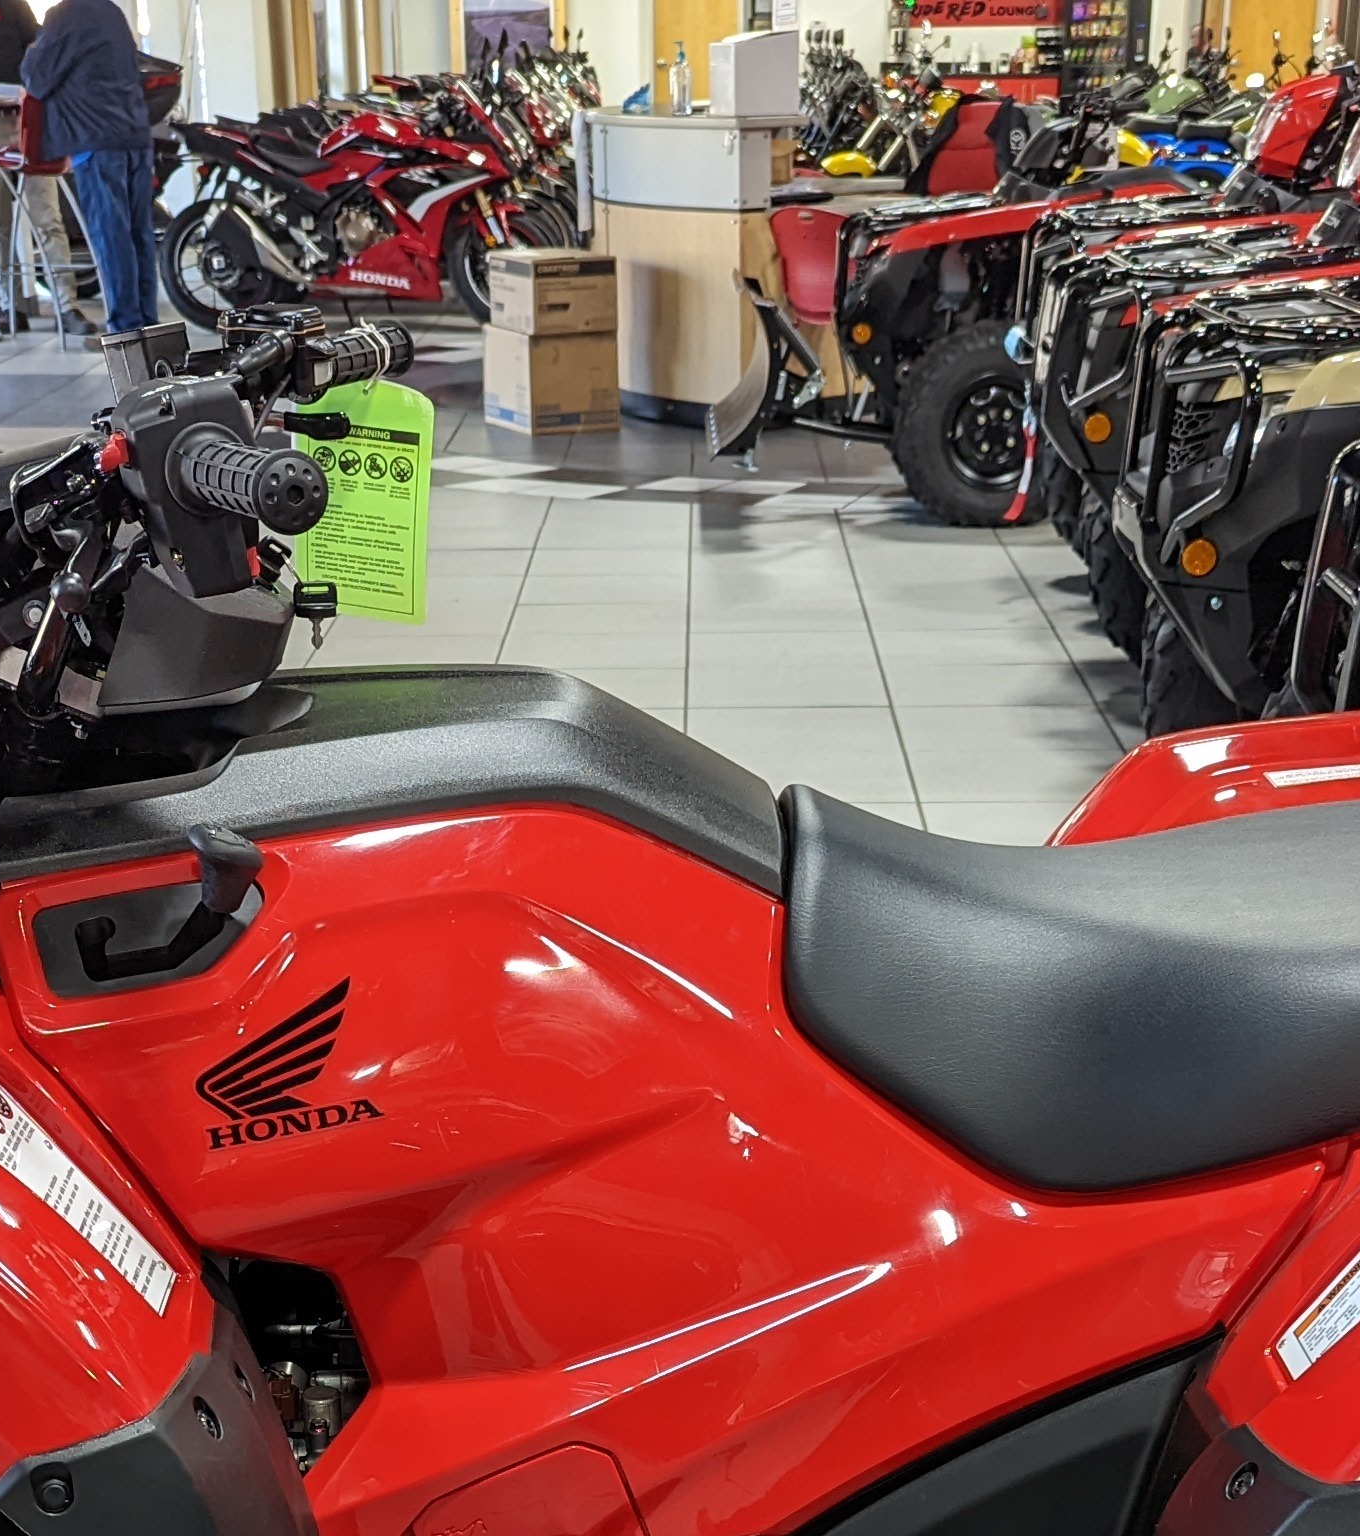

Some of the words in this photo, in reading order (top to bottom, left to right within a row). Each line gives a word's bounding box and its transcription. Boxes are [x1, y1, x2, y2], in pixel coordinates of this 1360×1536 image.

[945, 0, 987, 22] RED
[990, 5, 1047, 17] LOUNG
[349, 269, 411, 290] HONDA
[349, 427, 391, 440] WARNING
[206, 1099, 385, 1150] HONDA
